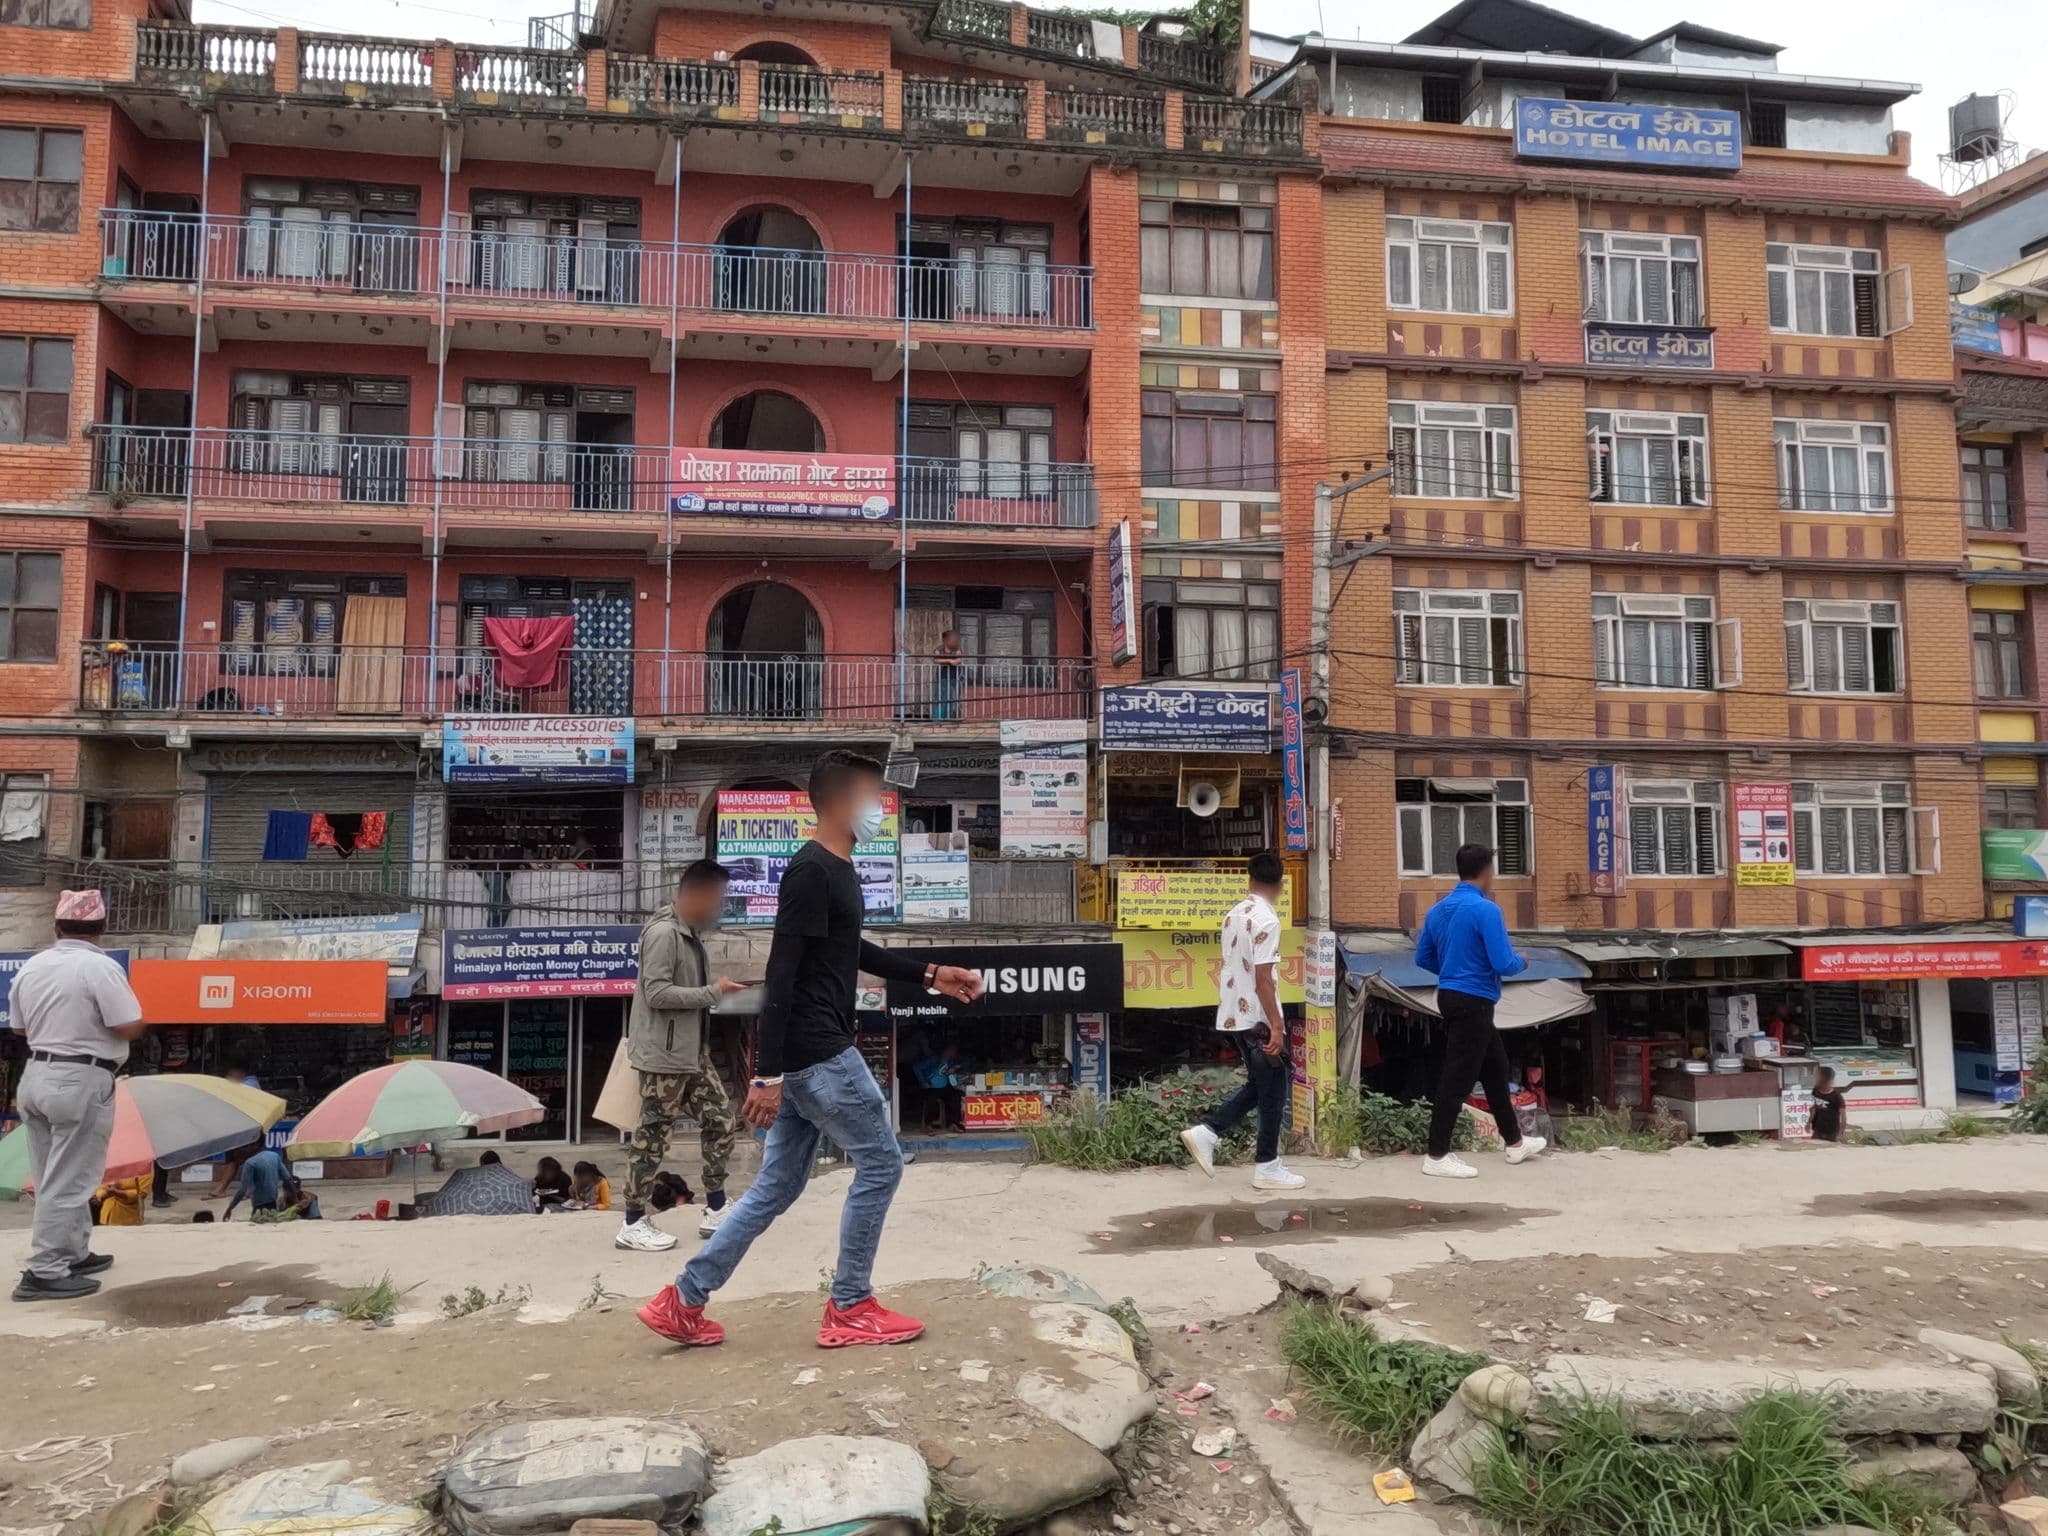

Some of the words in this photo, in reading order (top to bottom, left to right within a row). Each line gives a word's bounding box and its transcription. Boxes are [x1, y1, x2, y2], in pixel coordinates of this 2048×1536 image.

[1549, 103, 1641, 130] होटल
[1652, 111, 1734, 137] ईमेज
[1526, 128, 1627, 150] HOTEL
[1636, 135, 1733, 156] IMAGE
[1589, 330, 1650, 355] होटल
[1656, 332, 1711, 356] ईमेज
[680, 453, 731, 483] पोखरा
[844, 466, 887, 490] हाउस
[1216, 693, 1268, 717] केन्द्र
[452, 718, 472, 731] BS
[477, 717, 530, 732] Mobile
[533, 717, 626, 733] Accessories
[719, 793, 791, 806] MANASAROVAR
[796, 797, 811, 806] TRA
[1590, 790, 1612, 801] HOTEL
[719, 819, 737, 840] AIR
[740, 818, 798, 840] TICKETING
[1596, 802, 1610, 872] IMAGE
[719, 841, 789, 853] KATHMANDU
[727, 884, 757, 896] CKAGE
[750, 896, 779, 905] JUNGL
[506, 941, 561, 959] होराइजन
[563, 939, 589, 956] मनि
[454, 961, 501, 975] Himalaya
[504, 960, 544, 972] Horizen
[546, 960, 580, 973] Money
[582, 958, 625, 972] Changer
[1125, 948, 1195, 991] फोटो
[926, 966, 1087, 996] MSUNG
[242, 984, 312, 1000] xiaomi
[890, 1006, 914, 1017] Vanji
[917, 1005, 949, 1017] Mobile
[966, 1097, 997, 1118] फोटो
